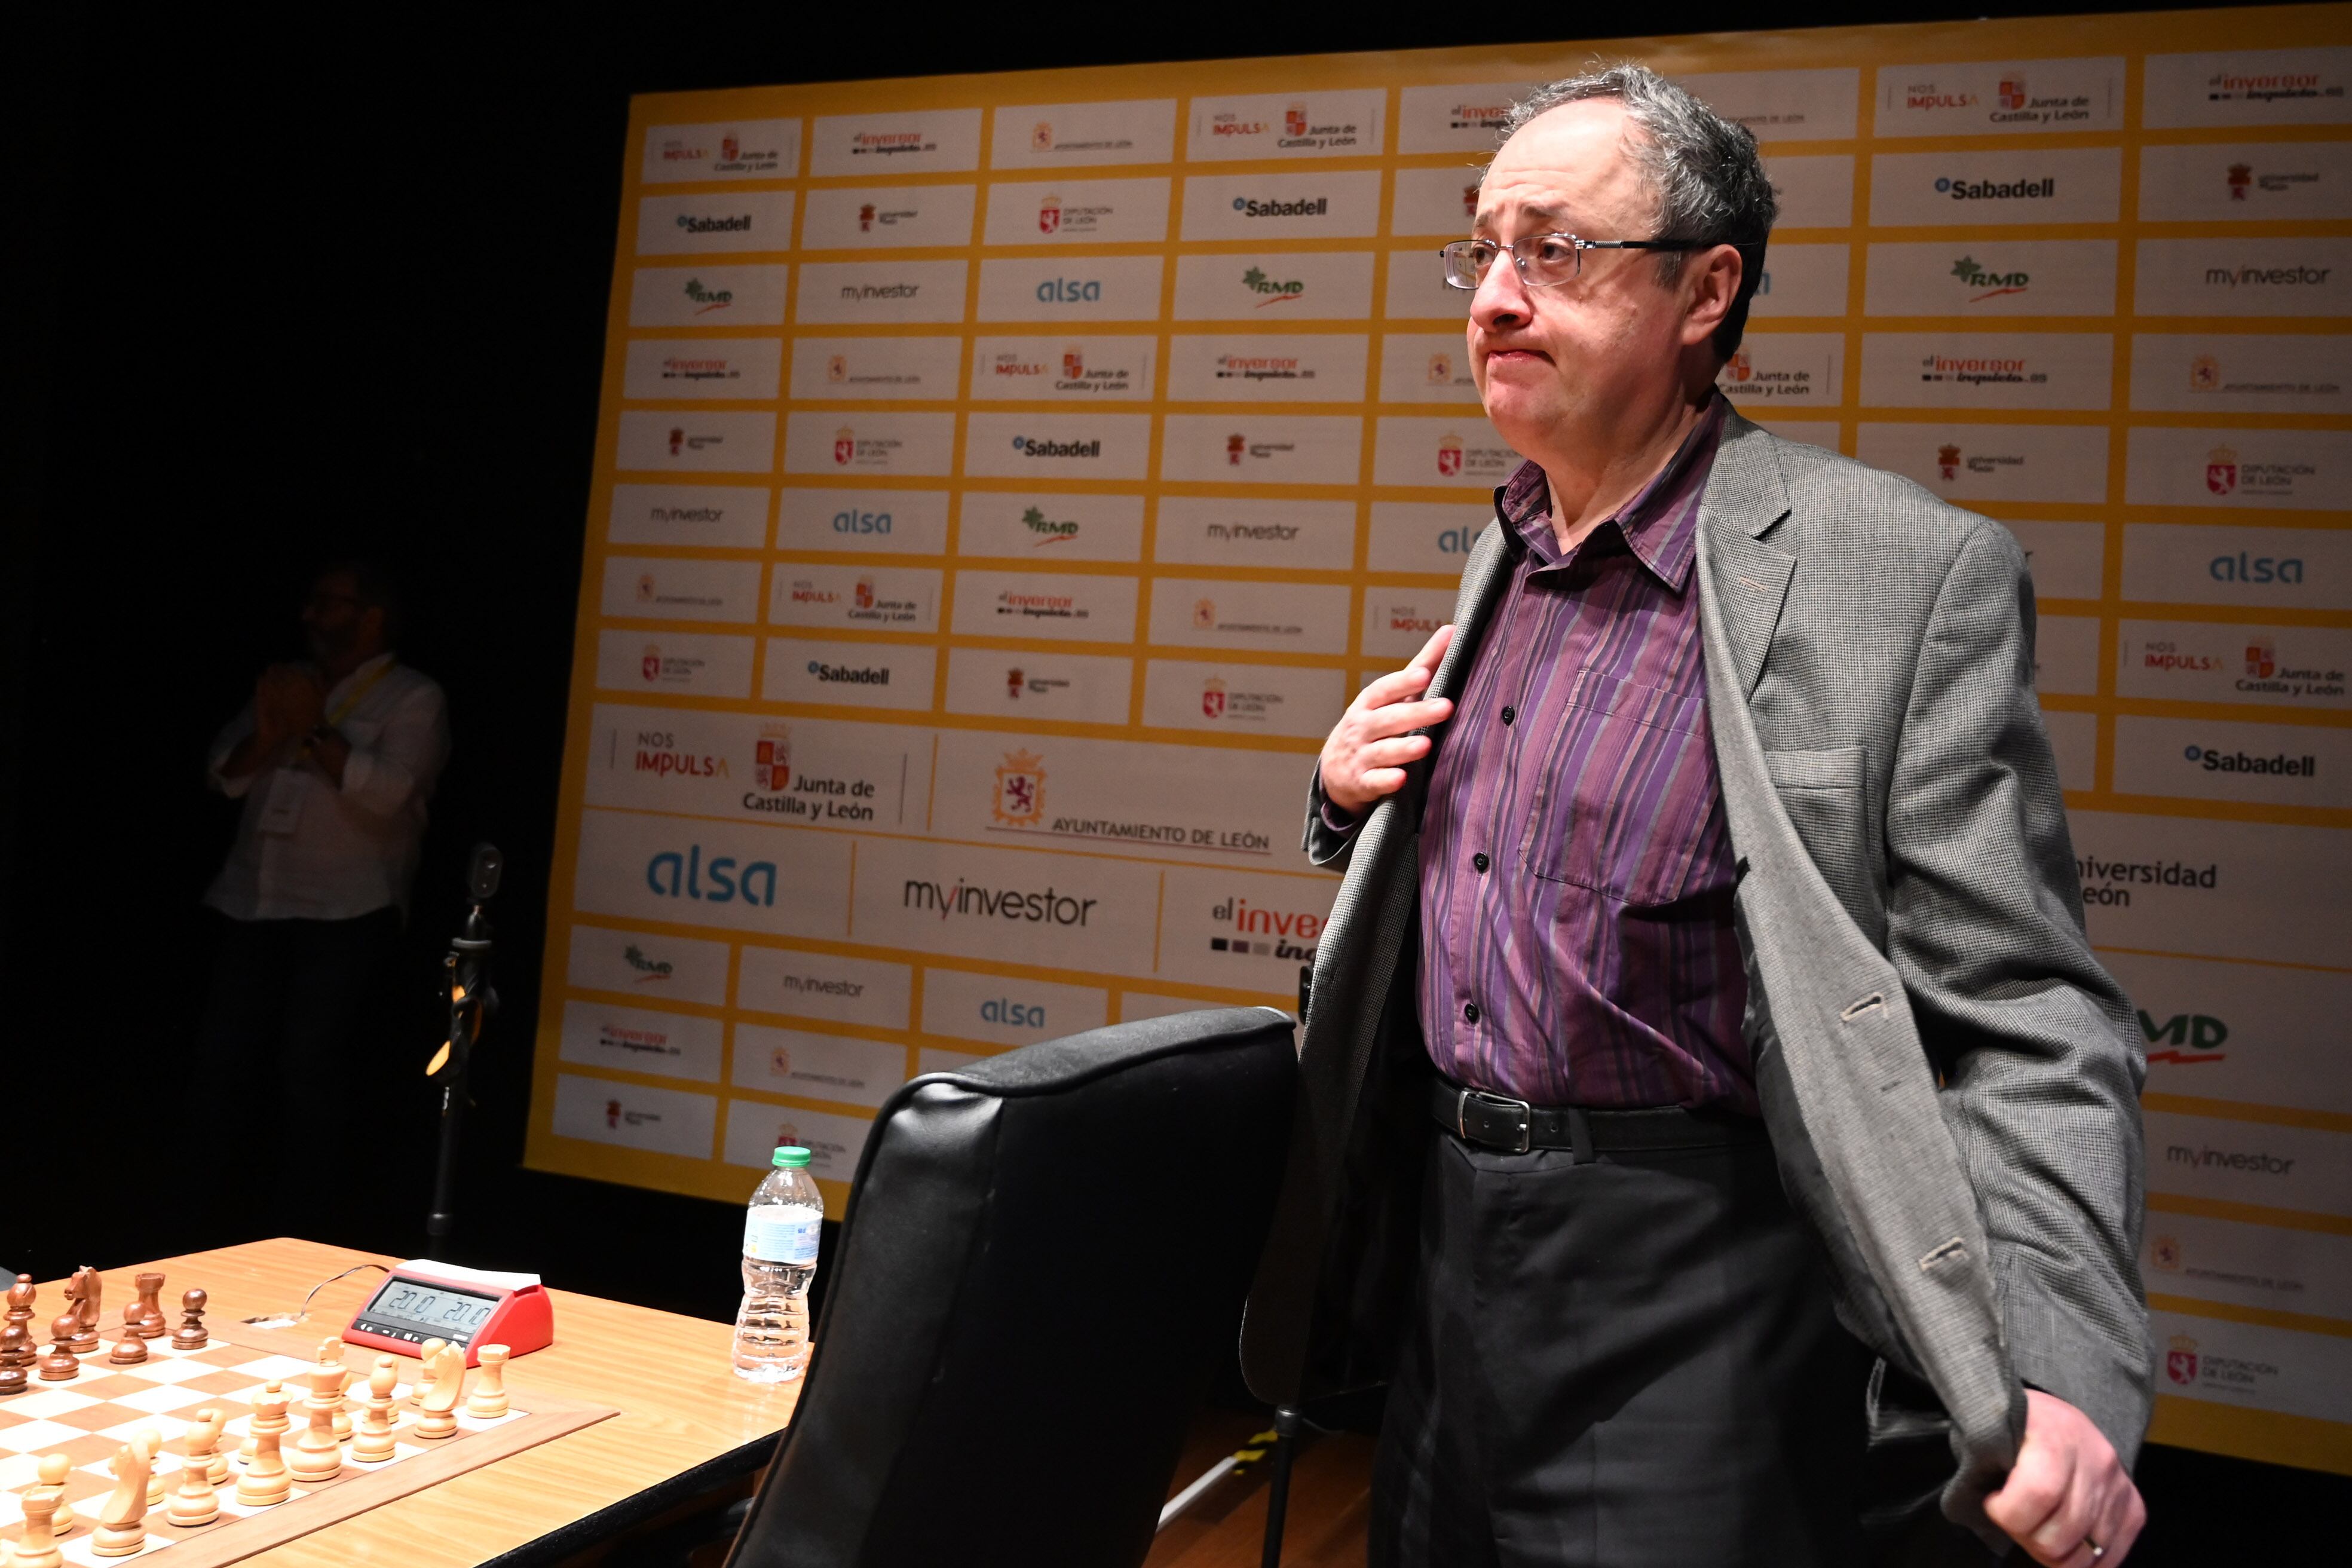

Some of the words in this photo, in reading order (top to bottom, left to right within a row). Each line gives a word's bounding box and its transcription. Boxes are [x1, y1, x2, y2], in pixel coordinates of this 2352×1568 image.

[1907, 95, 1978, 110] IMPULSA
[2028, 97, 2069, 109] Junta
[2073, 96, 2088, 106] de
[1989, 110, 2038, 122] Castilla
[2042, 112, 2050, 124] y
[2054, 109, 2088, 121] León
[1213, 123, 1269, 137] IMPULSA
[1310, 125, 1339, 136] Junta
[1343, 124, 1356, 134] de
[1278, 137, 1315, 148] Castilla
[1319, 139, 1325, 149] y
[1329, 136, 1356, 147] León
[1952, 178, 2053, 200] Sabadell
[1247, 198, 1327, 216] Sabadell
[688, 216, 751, 233] Sabadell
[1258, 281, 1303, 295] RMD
[1970, 272, 2029, 287] RMD
[2206, 265, 2330, 292] myinvestor
[842, 283, 919, 301] myinvestor
[1037, 278, 1100, 302] alsa
[1754, 372, 1789, 381] Junta
[1794, 372, 1809, 381] de
[1766, 387, 1773, 397] y
[1777, 383, 1809, 394] León
[1025, 440, 1100, 457] Sabadell
[651, 507, 723, 523] myinvestor
[833, 510, 891, 534] alsa
[1036, 522, 1078, 534] RMD
[1208, 523, 1297, 541] myinvestor
[1438, 526, 1482, 554] al
[2211, 552, 2303, 583] alsa
[2145, 654, 2222, 670] IMPULSA
[819, 665, 889, 685] Sabadell
[2278, 667, 2321, 681] Junta
[2326, 670, 2344, 682] de
[2236, 679, 2289, 694] Castilla
[2293, 685, 2301, 696] y
[2306, 682, 2344, 696] León
[638, 733, 674, 748] NOS
[636, 752, 730, 778] IMPULSA
[2203, 750, 2314, 776] Sabadell
[794, 776, 846, 795] Junta
[852, 779, 875, 798] de
[744, 794, 806, 815] Castilla
[812, 801, 822, 821] y
[829, 800, 873, 820] León
[1053, 817, 1186, 843] AYUNTAMIENTO
[1192, 829, 1214, 845] DE
[1221, 829, 1269, 849] LEÓN
[648, 845, 776, 907] alsa
[2077, 856, 2216, 888] niversidad
[905, 877, 1095, 926] myinvestor
[2082, 881, 2130, 906] eón
[1213, 897, 1233, 921] el
[1238, 898, 1329, 938] inve
[783, 975, 863, 997] myinvestor
[981, 998, 1045, 1028] alsa
[2137, 1010, 2228, 1049] MD
[2167, 1145, 2294, 1174] myinvestor
